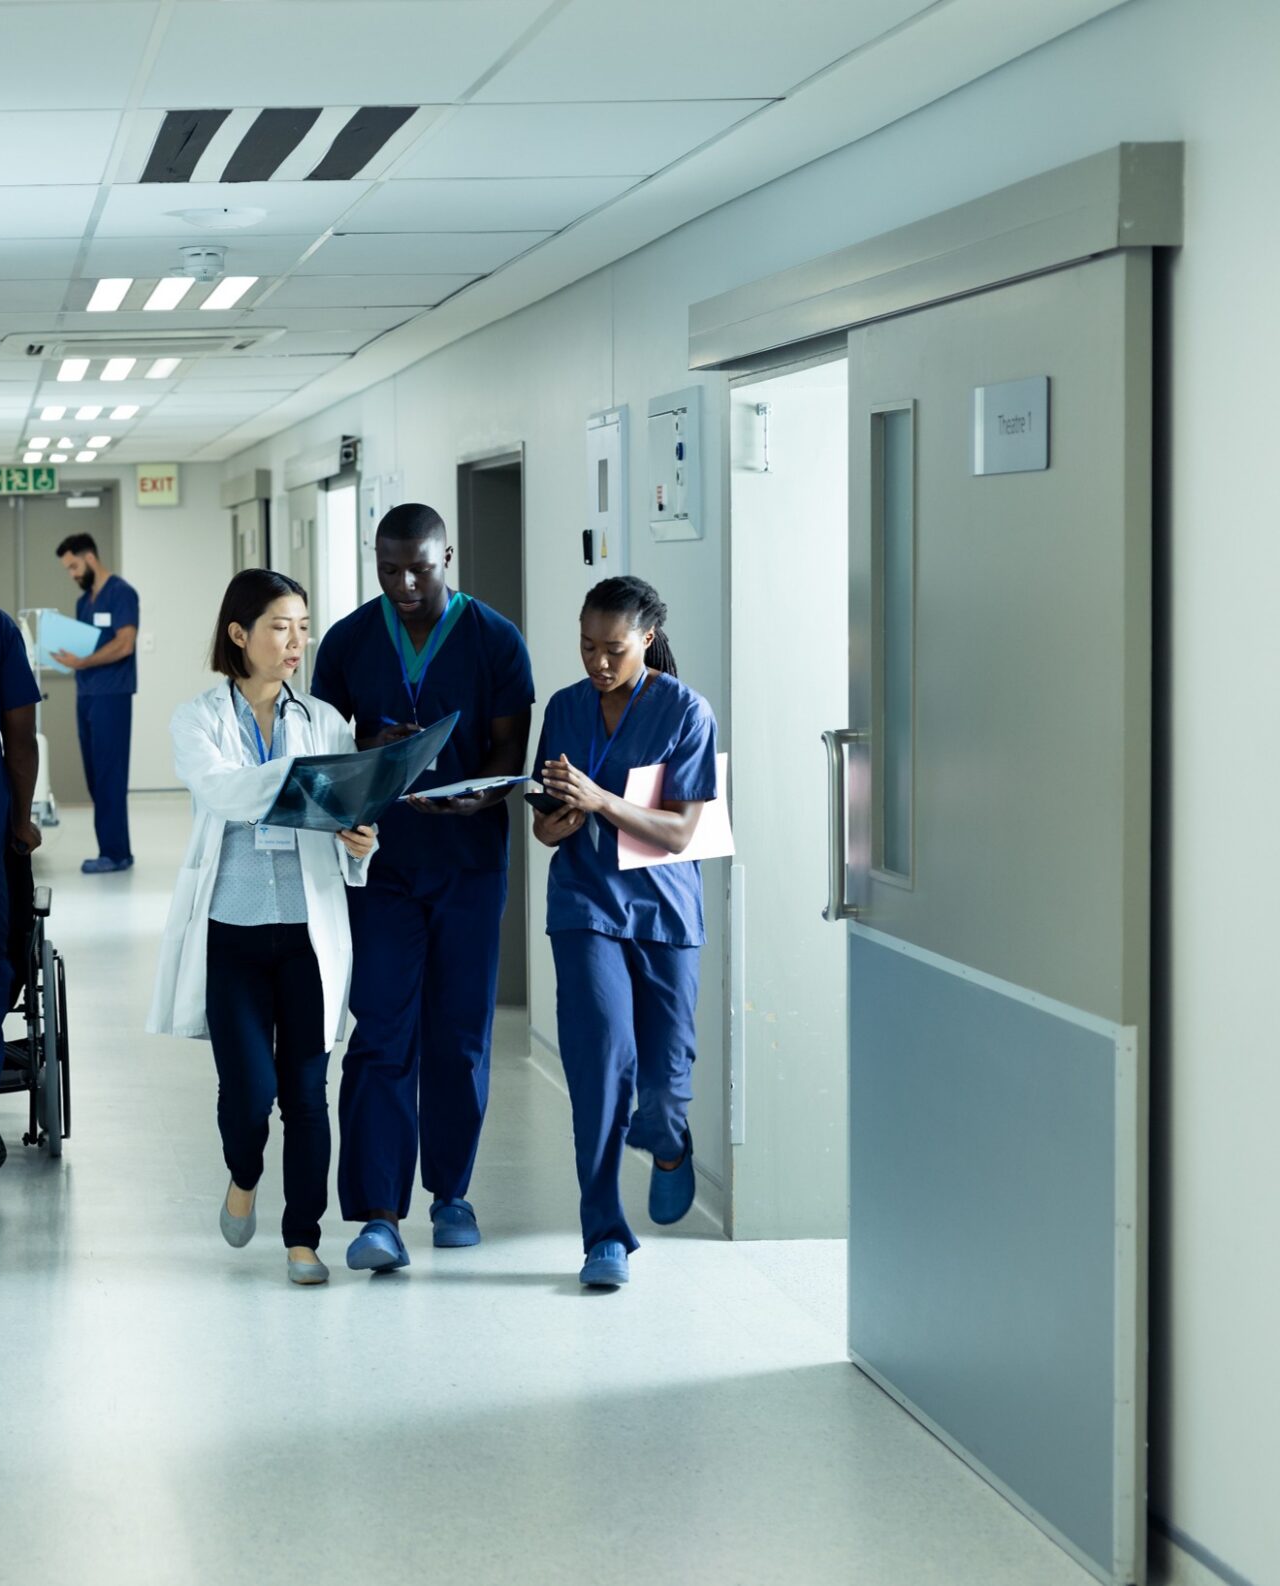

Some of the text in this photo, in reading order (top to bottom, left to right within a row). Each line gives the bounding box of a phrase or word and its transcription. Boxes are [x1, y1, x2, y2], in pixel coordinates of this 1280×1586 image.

[997, 411, 1032, 435] Theatre 1
[140, 477, 174, 492] EXIT
